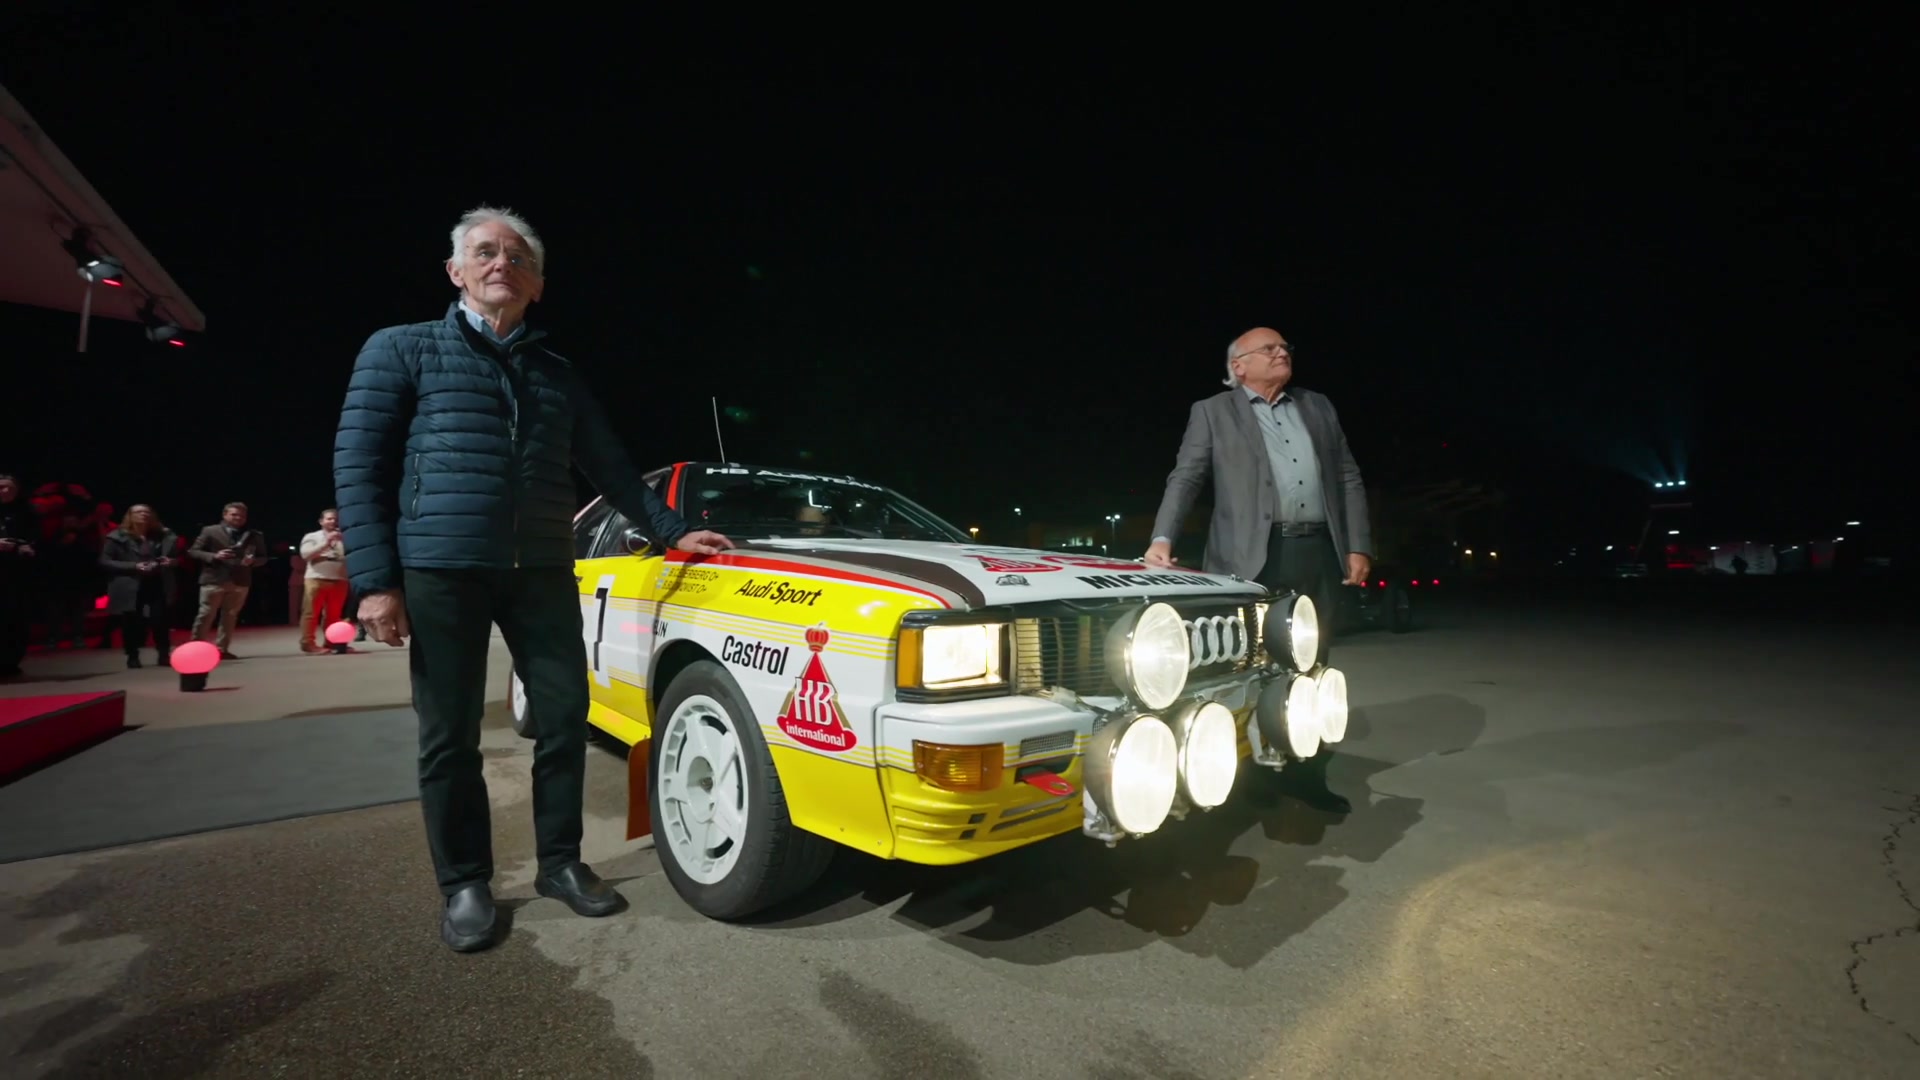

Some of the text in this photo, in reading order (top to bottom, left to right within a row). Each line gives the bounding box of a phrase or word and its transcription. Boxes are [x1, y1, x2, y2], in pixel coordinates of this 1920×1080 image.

[734, 579, 822, 606] Audi Sport
[1076, 574, 1223, 589] MICHELIN
[722, 635, 789, 675] Castrol
[794, 676, 835, 726] HB
[786, 721, 846, 747] international
